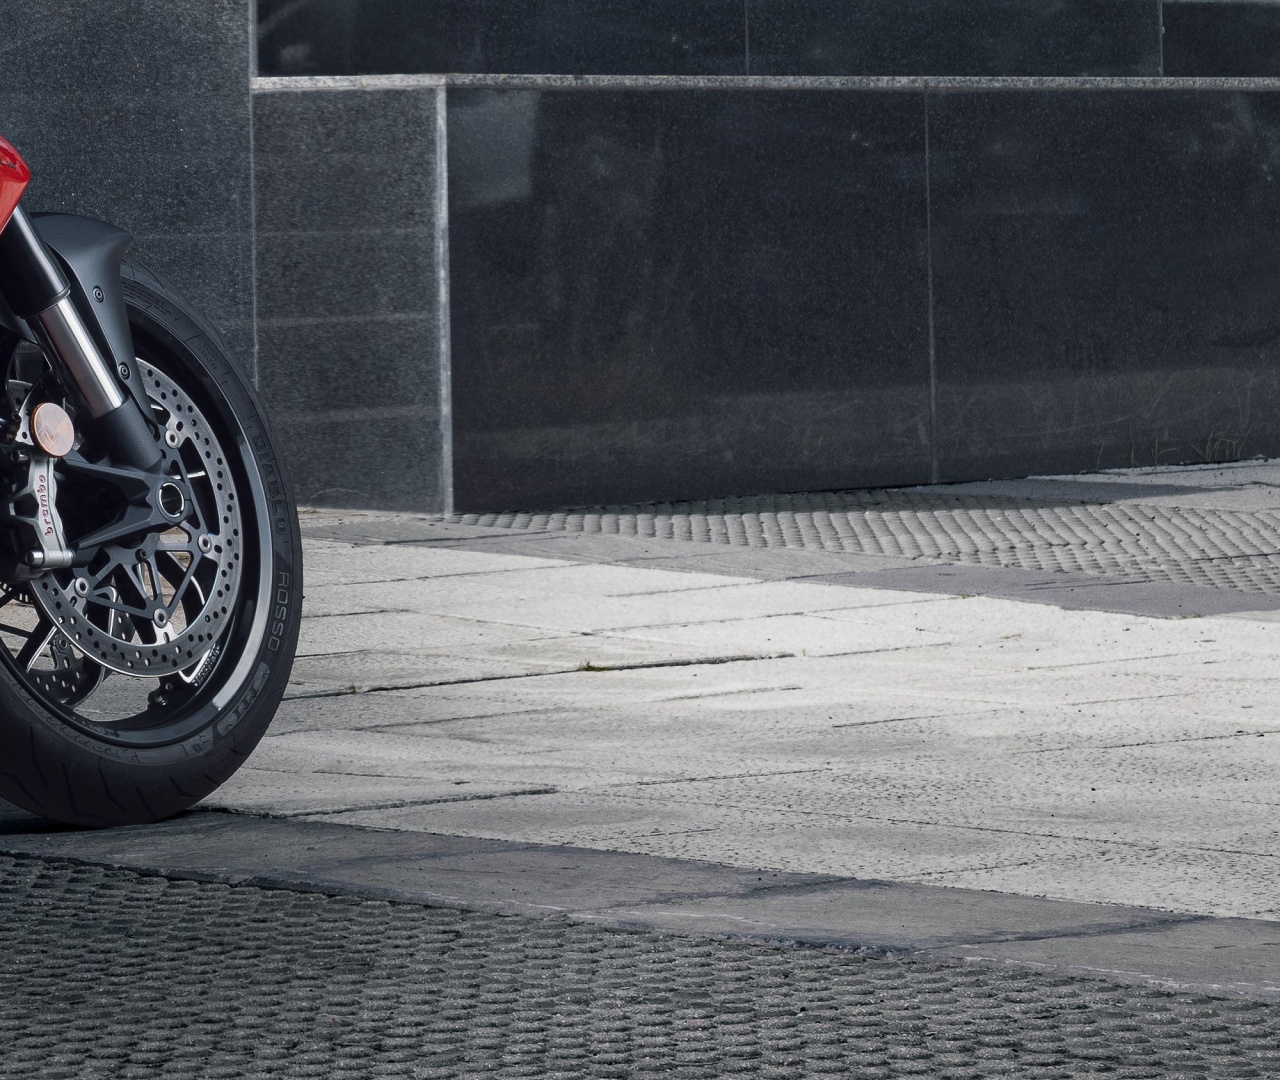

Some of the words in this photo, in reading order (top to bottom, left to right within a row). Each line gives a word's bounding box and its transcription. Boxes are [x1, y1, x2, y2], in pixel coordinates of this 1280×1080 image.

[37, 474, 54, 536] brembo
[252, 433, 287, 535] DIABLO
[267, 571, 290, 653] ROSSO
